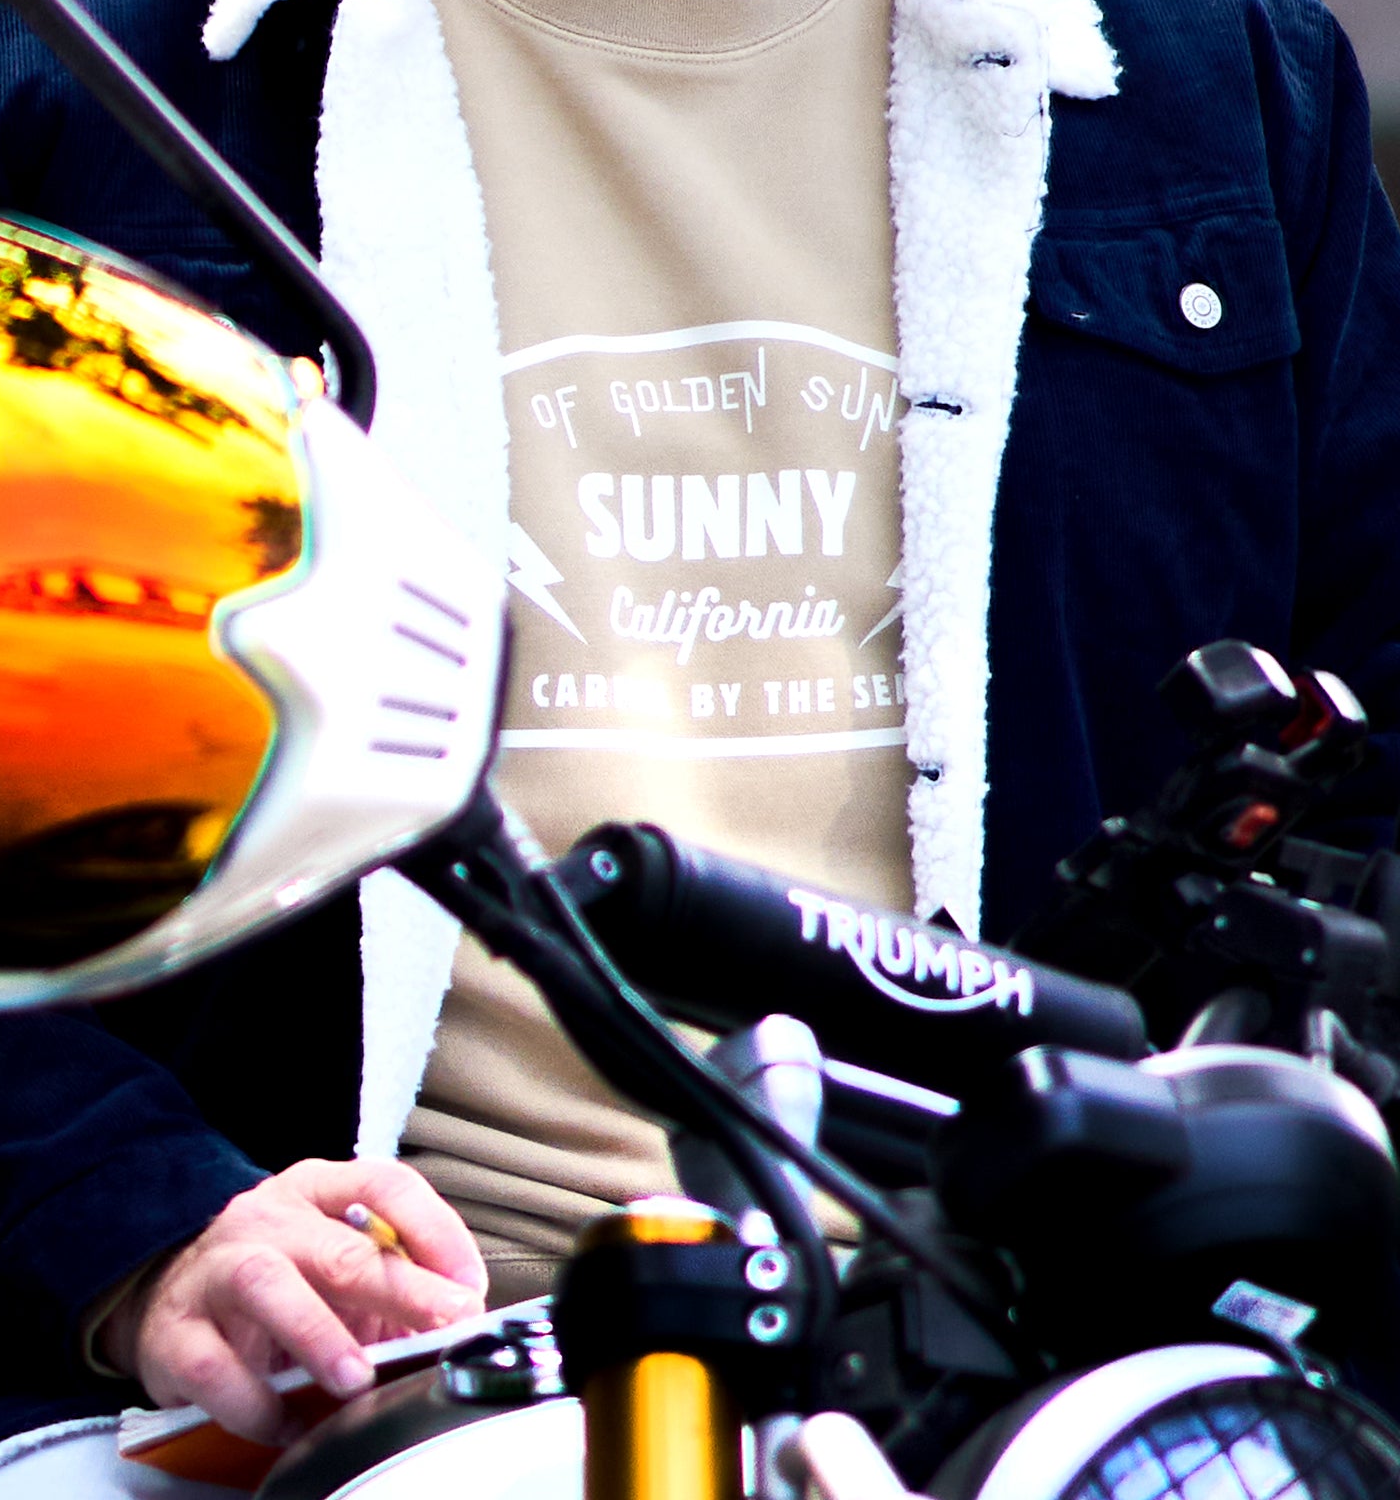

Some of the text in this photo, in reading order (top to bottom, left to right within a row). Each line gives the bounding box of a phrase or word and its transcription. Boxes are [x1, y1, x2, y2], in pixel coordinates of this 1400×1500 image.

[531, 385, 577, 448] OF
[610, 347, 766, 437] GOLDEN
[577, 469, 856, 562] SUNNY
[610, 585, 845, 666] California
[691, 683, 742, 718] BY
[763, 677, 836, 714] THE
[788, 888, 1034, 1016] TRIUMPH
